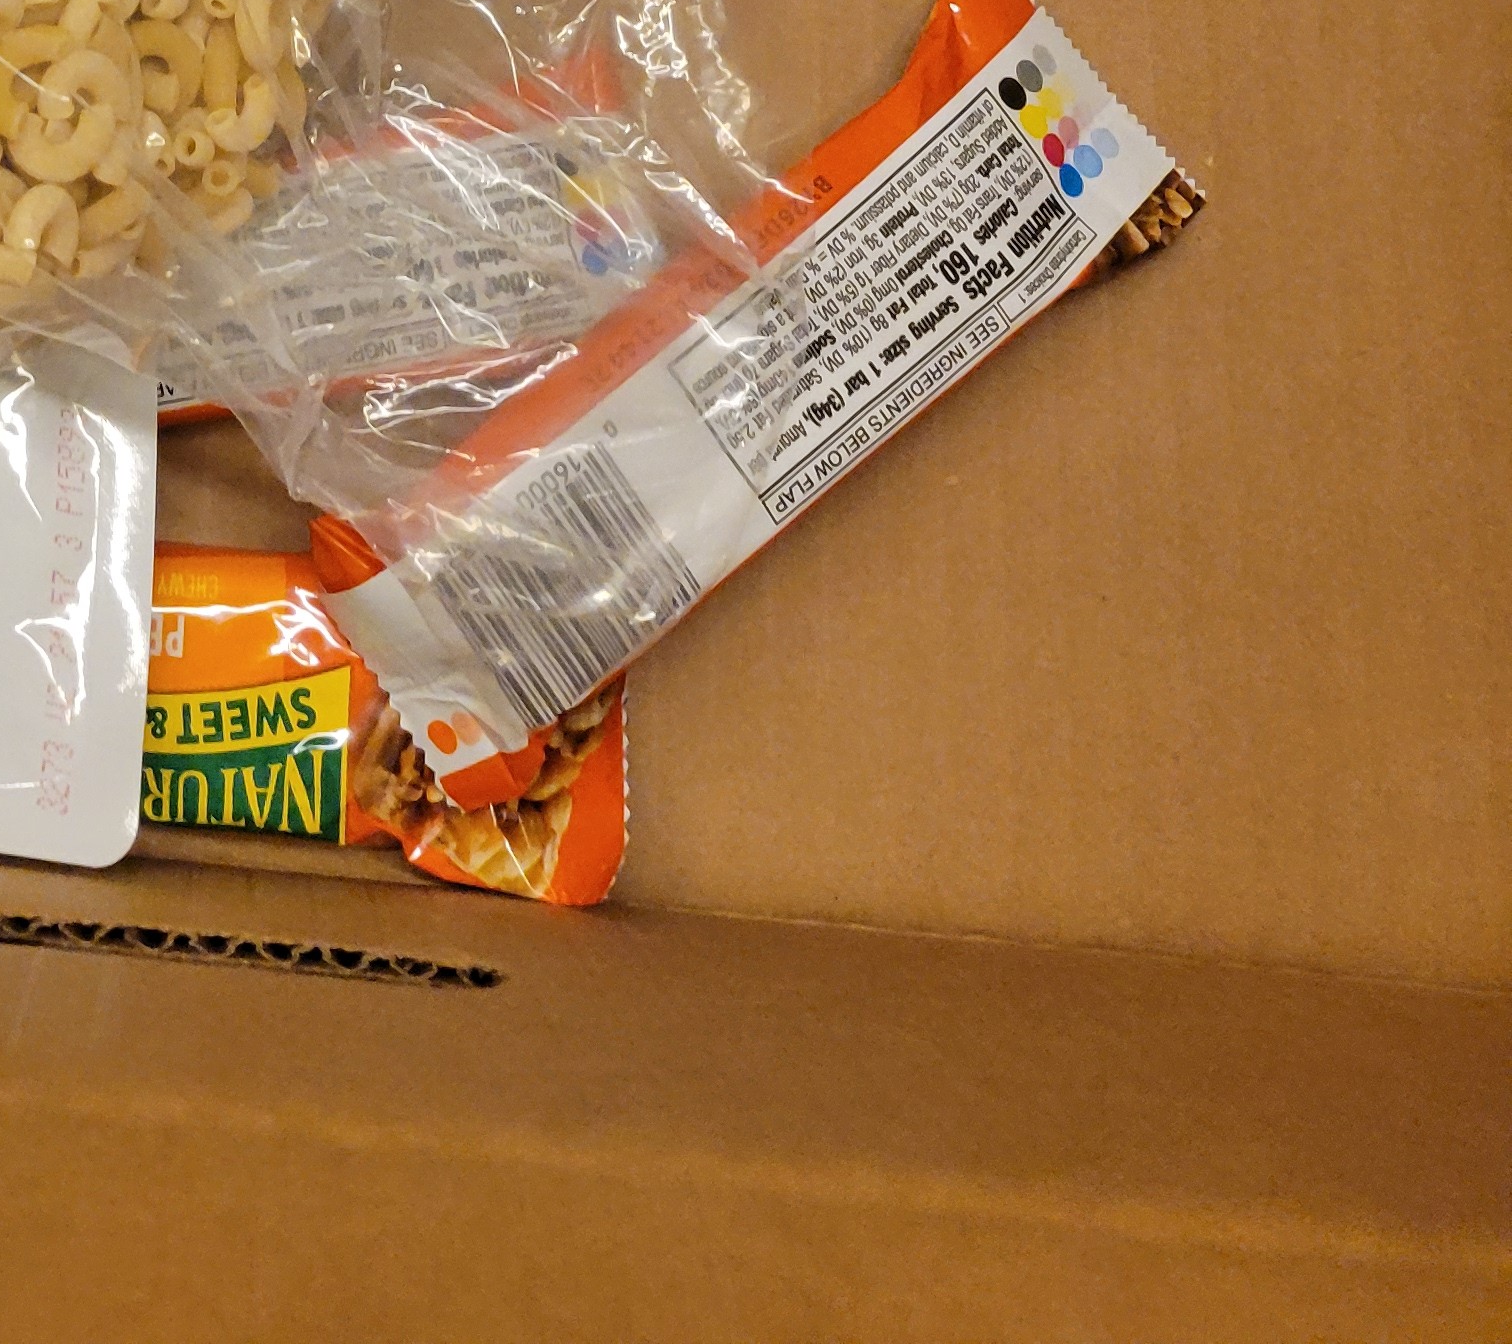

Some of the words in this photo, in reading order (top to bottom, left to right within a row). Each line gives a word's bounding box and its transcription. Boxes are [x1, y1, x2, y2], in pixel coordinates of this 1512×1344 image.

[978, 114, 1010, 146] Added
[911, 139, 951, 178] calcium
[894, 169, 919, 194] and
[973, 183, 1002, 212] Trans
[876, 199, 919, 241] Protein
[961, 203, 982, 224] Fat
[970, 196, 1022, 247] Calories
[1001, 193, 1070, 261] Nutrition
[842, 245, 869, 272] Iron
[889, 218, 930, 260] Dietary
[892, 226, 955, 288] Cholesterol
[866, 247, 899, 280] Fiber
[959, 250, 1016, 306] Facts
[904, 272, 938, 305] Total
[867, 309, 890, 333] 8g
[884, 295, 911, 322] Fat
[905, 289, 961, 345] Serving
[962, 311, 999, 347] SEE
[876, 332, 914, 370] size:
[839, 368, 869, 398] bar
[864, 338, 970, 433] INGREDIENTS
[799, 384, 848, 432] (34g),
[810, 424, 871, 481] BELOW
[512, 446, 584, 517] 16000
[769, 472, 816, 516] FLAP
[158, 574, 219, 599] CHEWY
[146, 707, 167, 738] &
[177, 688, 316, 745] SWEET
[143, 748, 323, 835] NATUR
